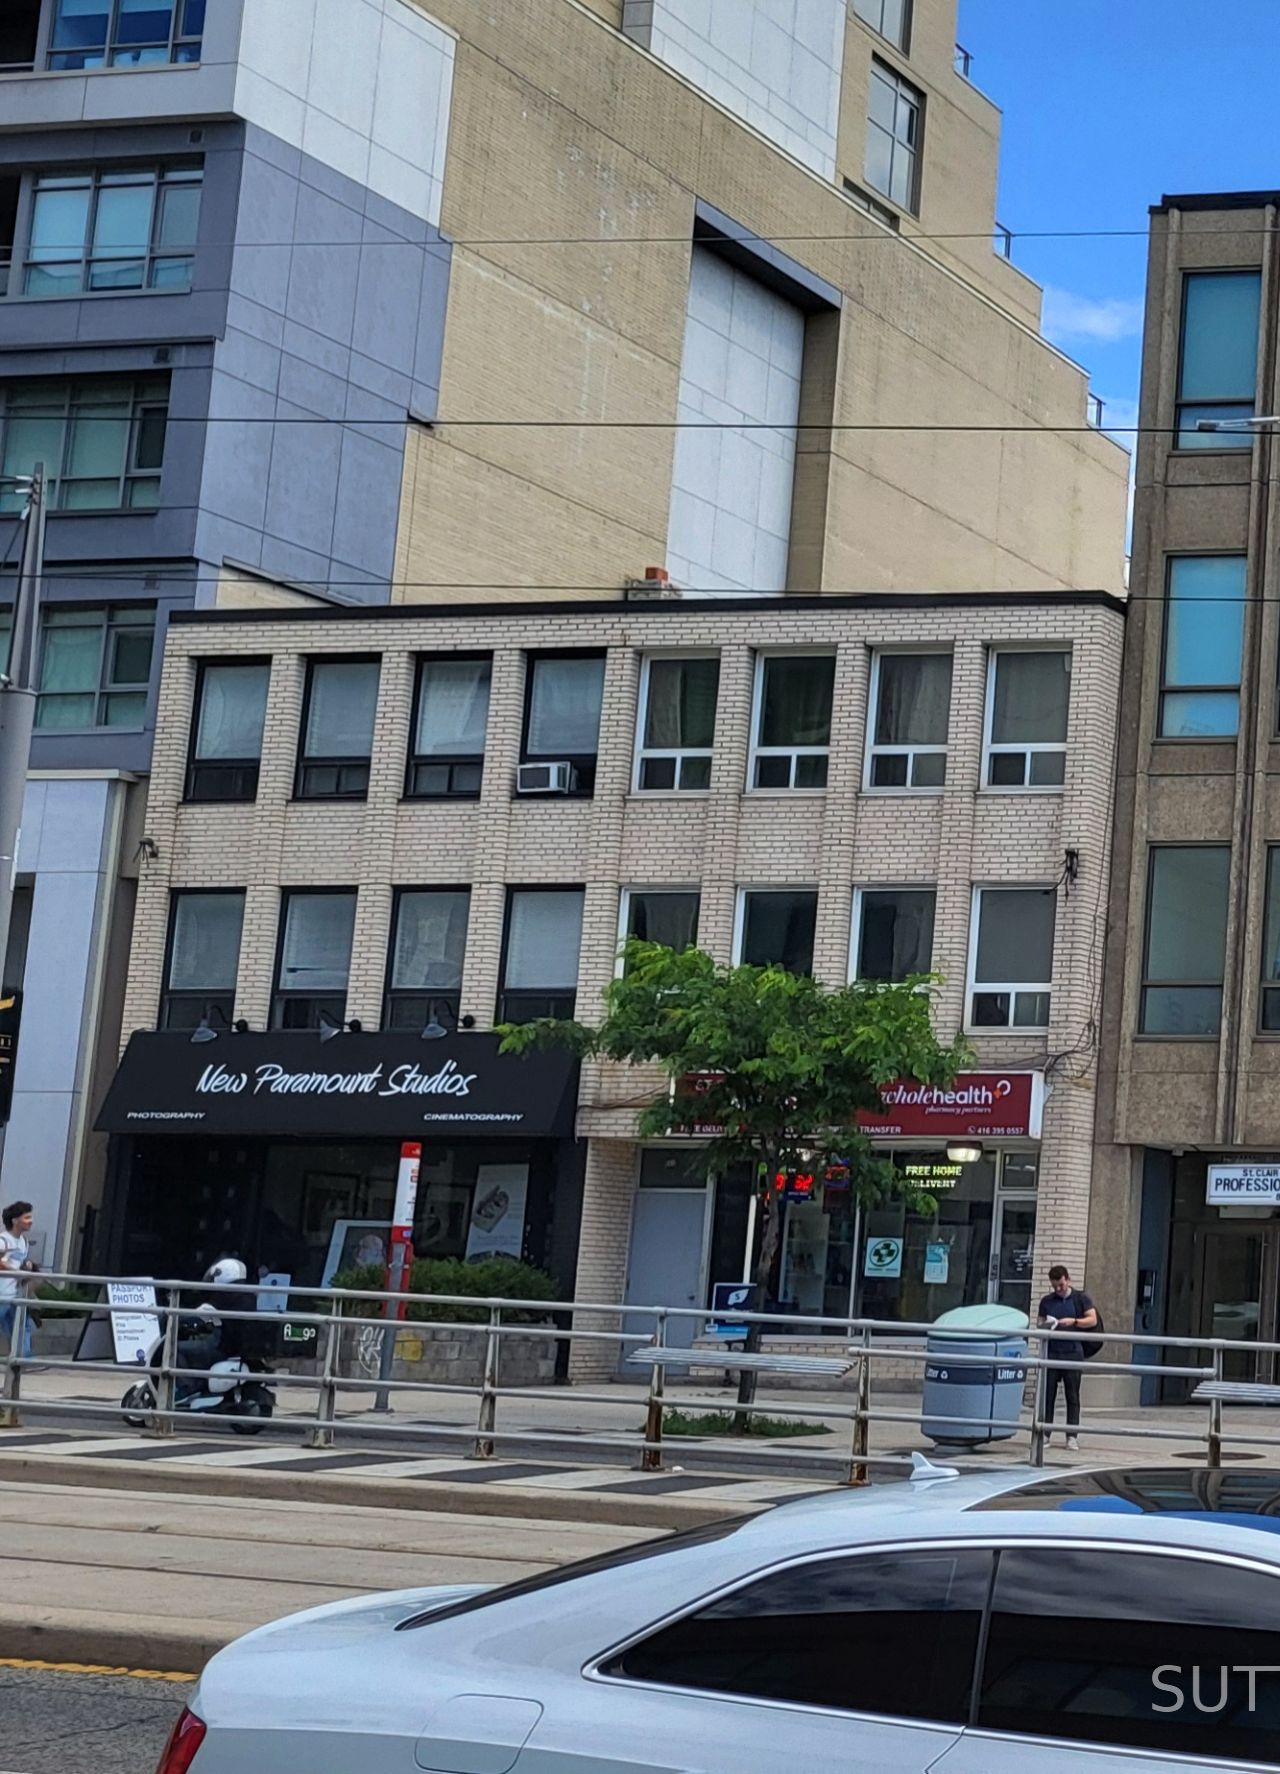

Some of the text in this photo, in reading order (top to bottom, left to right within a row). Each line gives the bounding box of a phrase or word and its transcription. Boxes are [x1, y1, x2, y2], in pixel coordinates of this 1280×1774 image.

[195, 1059, 477, 1096] New Paramount Studios
[881, 1084, 993, 1105] wholehealth
[127, 1111, 206, 1119] PHOTOGRAPHY
[423, 1113, 524, 1121] CINEMATOGRAPHY
[905, 1165, 962, 1176] FREE HOME
[1256, 1169, 1279, 1177] CLAIR
[112, 1294, 145, 1304] PHOTOS
[997, 1368, 1017, 1380] Litter
